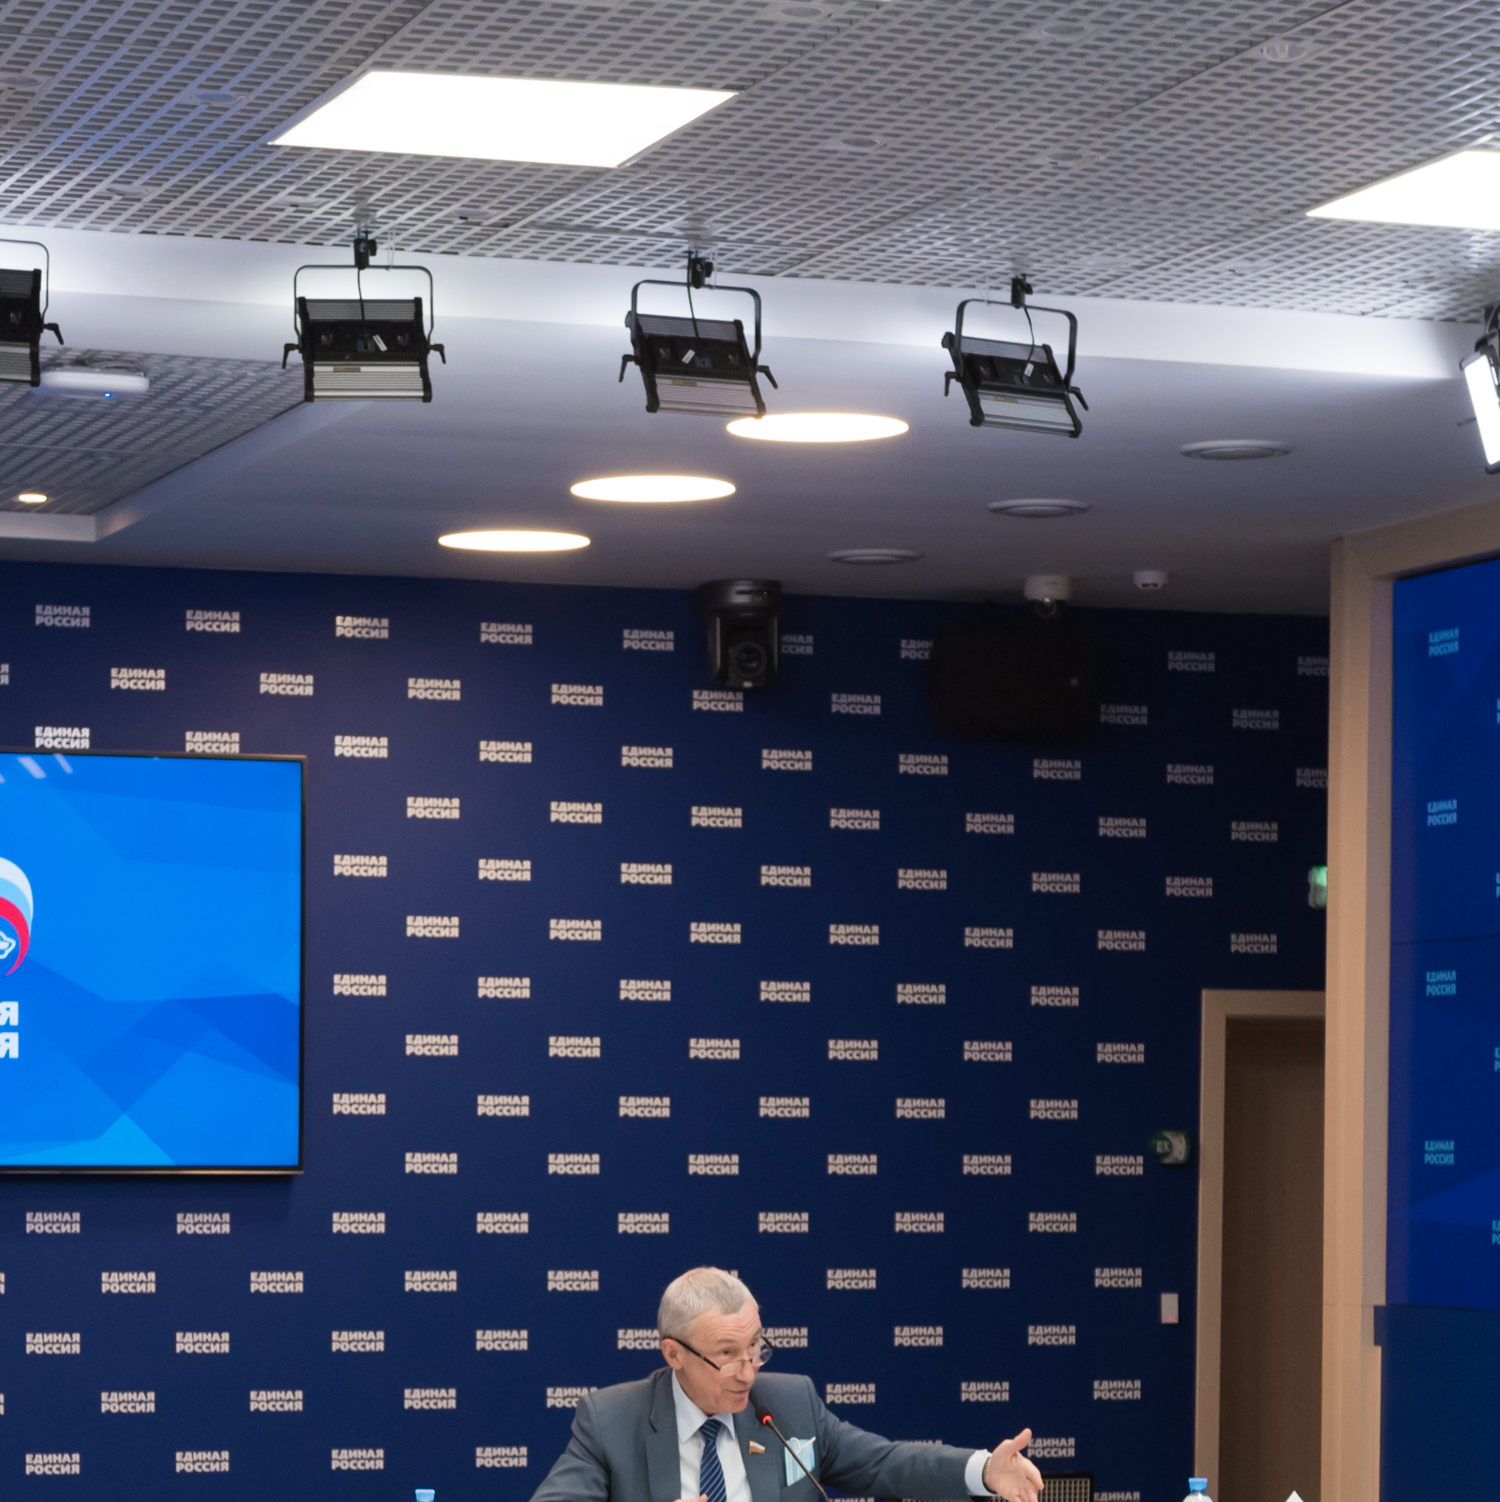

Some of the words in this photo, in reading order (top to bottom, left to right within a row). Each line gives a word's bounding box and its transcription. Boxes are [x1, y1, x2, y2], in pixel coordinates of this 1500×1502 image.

[480, 622, 533, 633] ЕДИНАЯ
[479, 632, 533, 644] РОССИЯ
[110, 668, 166, 679] ЕДИНАЯ
[110, 678, 166, 690] РОССИЯ
[551, 684, 604, 695] ЕДИНАЯ
[550, 694, 604, 706] РОССИЯ
[334, 736, 389, 747] ЕДИНАЯ
[333, 746, 389, 758] РОССИЯ
[621, 746, 673, 757] ЕДИНАЯ
[621, 756, 673, 767] РОССИЯ
[549, 802, 603, 813] ЕДИНАЯ
[549, 812, 603, 823] РОССИЯ
[829, 808, 881, 819] ЕДИНАЯ
[829, 818, 880, 829] РОССИЯ
[333, 855, 388, 866] ЕДИНАЯ
[333, 865, 388, 877] РОССИЯ
[620, 863, 673, 874] ЕДИНАЯ
[620, 873, 673, 884] РОССИЯ
[549, 919, 602, 930] ЕДИНАЯ
[549, 929, 602, 940] РОССИЯ
[333, 974, 387, 985] ЕДИНАЯ
[619, 980, 672, 990] ЕДИНАЯ
[333, 984, 387, 996] РОССИЯ
[619, 990, 671, 1001] РОССИЯ
[548, 1036, 601, 1046] ЕДИНАЯ
[548, 1046, 601, 1057] РОССИЯ
[477, 1095, 530, 1106] ЕДИНАЯ
[759, 1097, 810, 1107] ЕДИНАЯ
[477, 1106, 530, 1116] РОССИЯ
[759, 1107, 810, 1117] РОССИЯ
[547, 1154, 601, 1164] ЕДИНАЯ
[962, 1155, 1012, 1164] ЕДИНАЯ
[547, 1164, 601, 1174] РОССИЯ
[962, 1164, 1012, 1174] РОССИЯ
[476, 1212, 529, 1223] ЕДИНАЯ
[476, 1222, 529, 1233] РОССИЯ
[101, 1272, 156, 1282] ЕДИНАЯ
[547, 1270, 599, 1281] ЕДИНАЯ
[101, 1282, 157, 1293] РОССИЯ
[547, 1280, 599, 1291] РОССИЯ
[249, 1390, 304, 1401] ЕДИНАЯ
[249, 1400, 303, 1411] РОССИЯ
